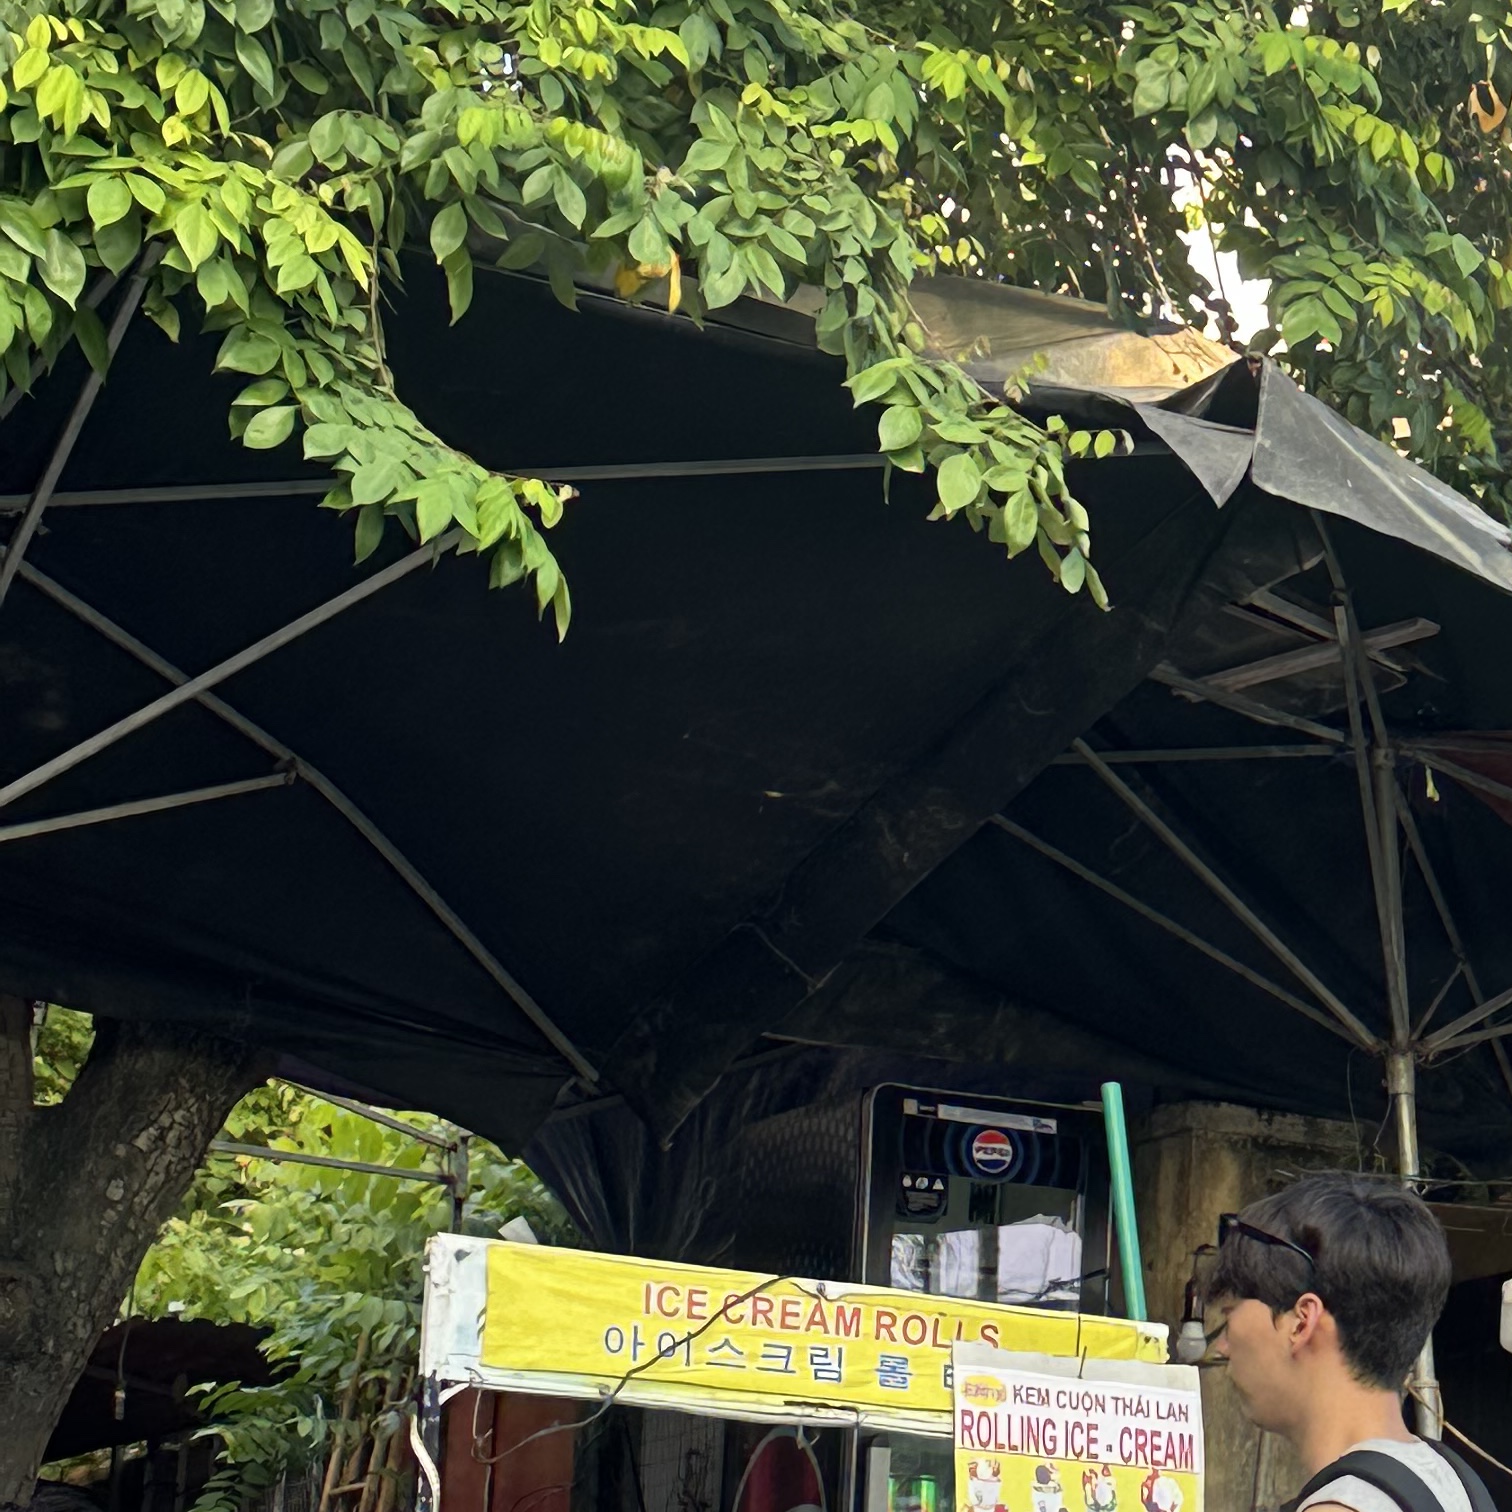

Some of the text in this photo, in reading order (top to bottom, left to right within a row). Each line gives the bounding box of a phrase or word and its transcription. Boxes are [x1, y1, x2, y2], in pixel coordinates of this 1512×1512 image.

[643, 1283, 708, 1321] ICE
[723, 1293, 861, 1338] CREAM
[603, 1324, 843, 1383] 아이스크림
[1013, 1385, 1050, 1407] KEM
[1056, 1391, 1105, 1417] CUỘN
[1111, 1395, 1150, 1418] THÁI
[1156, 1403, 1189, 1423] LAN
[961, 1409, 1057, 1456] ROLLING
[1065, 1420, 1099, 1460] ICE
[1119, 1426, 1195, 1470] CREAM
